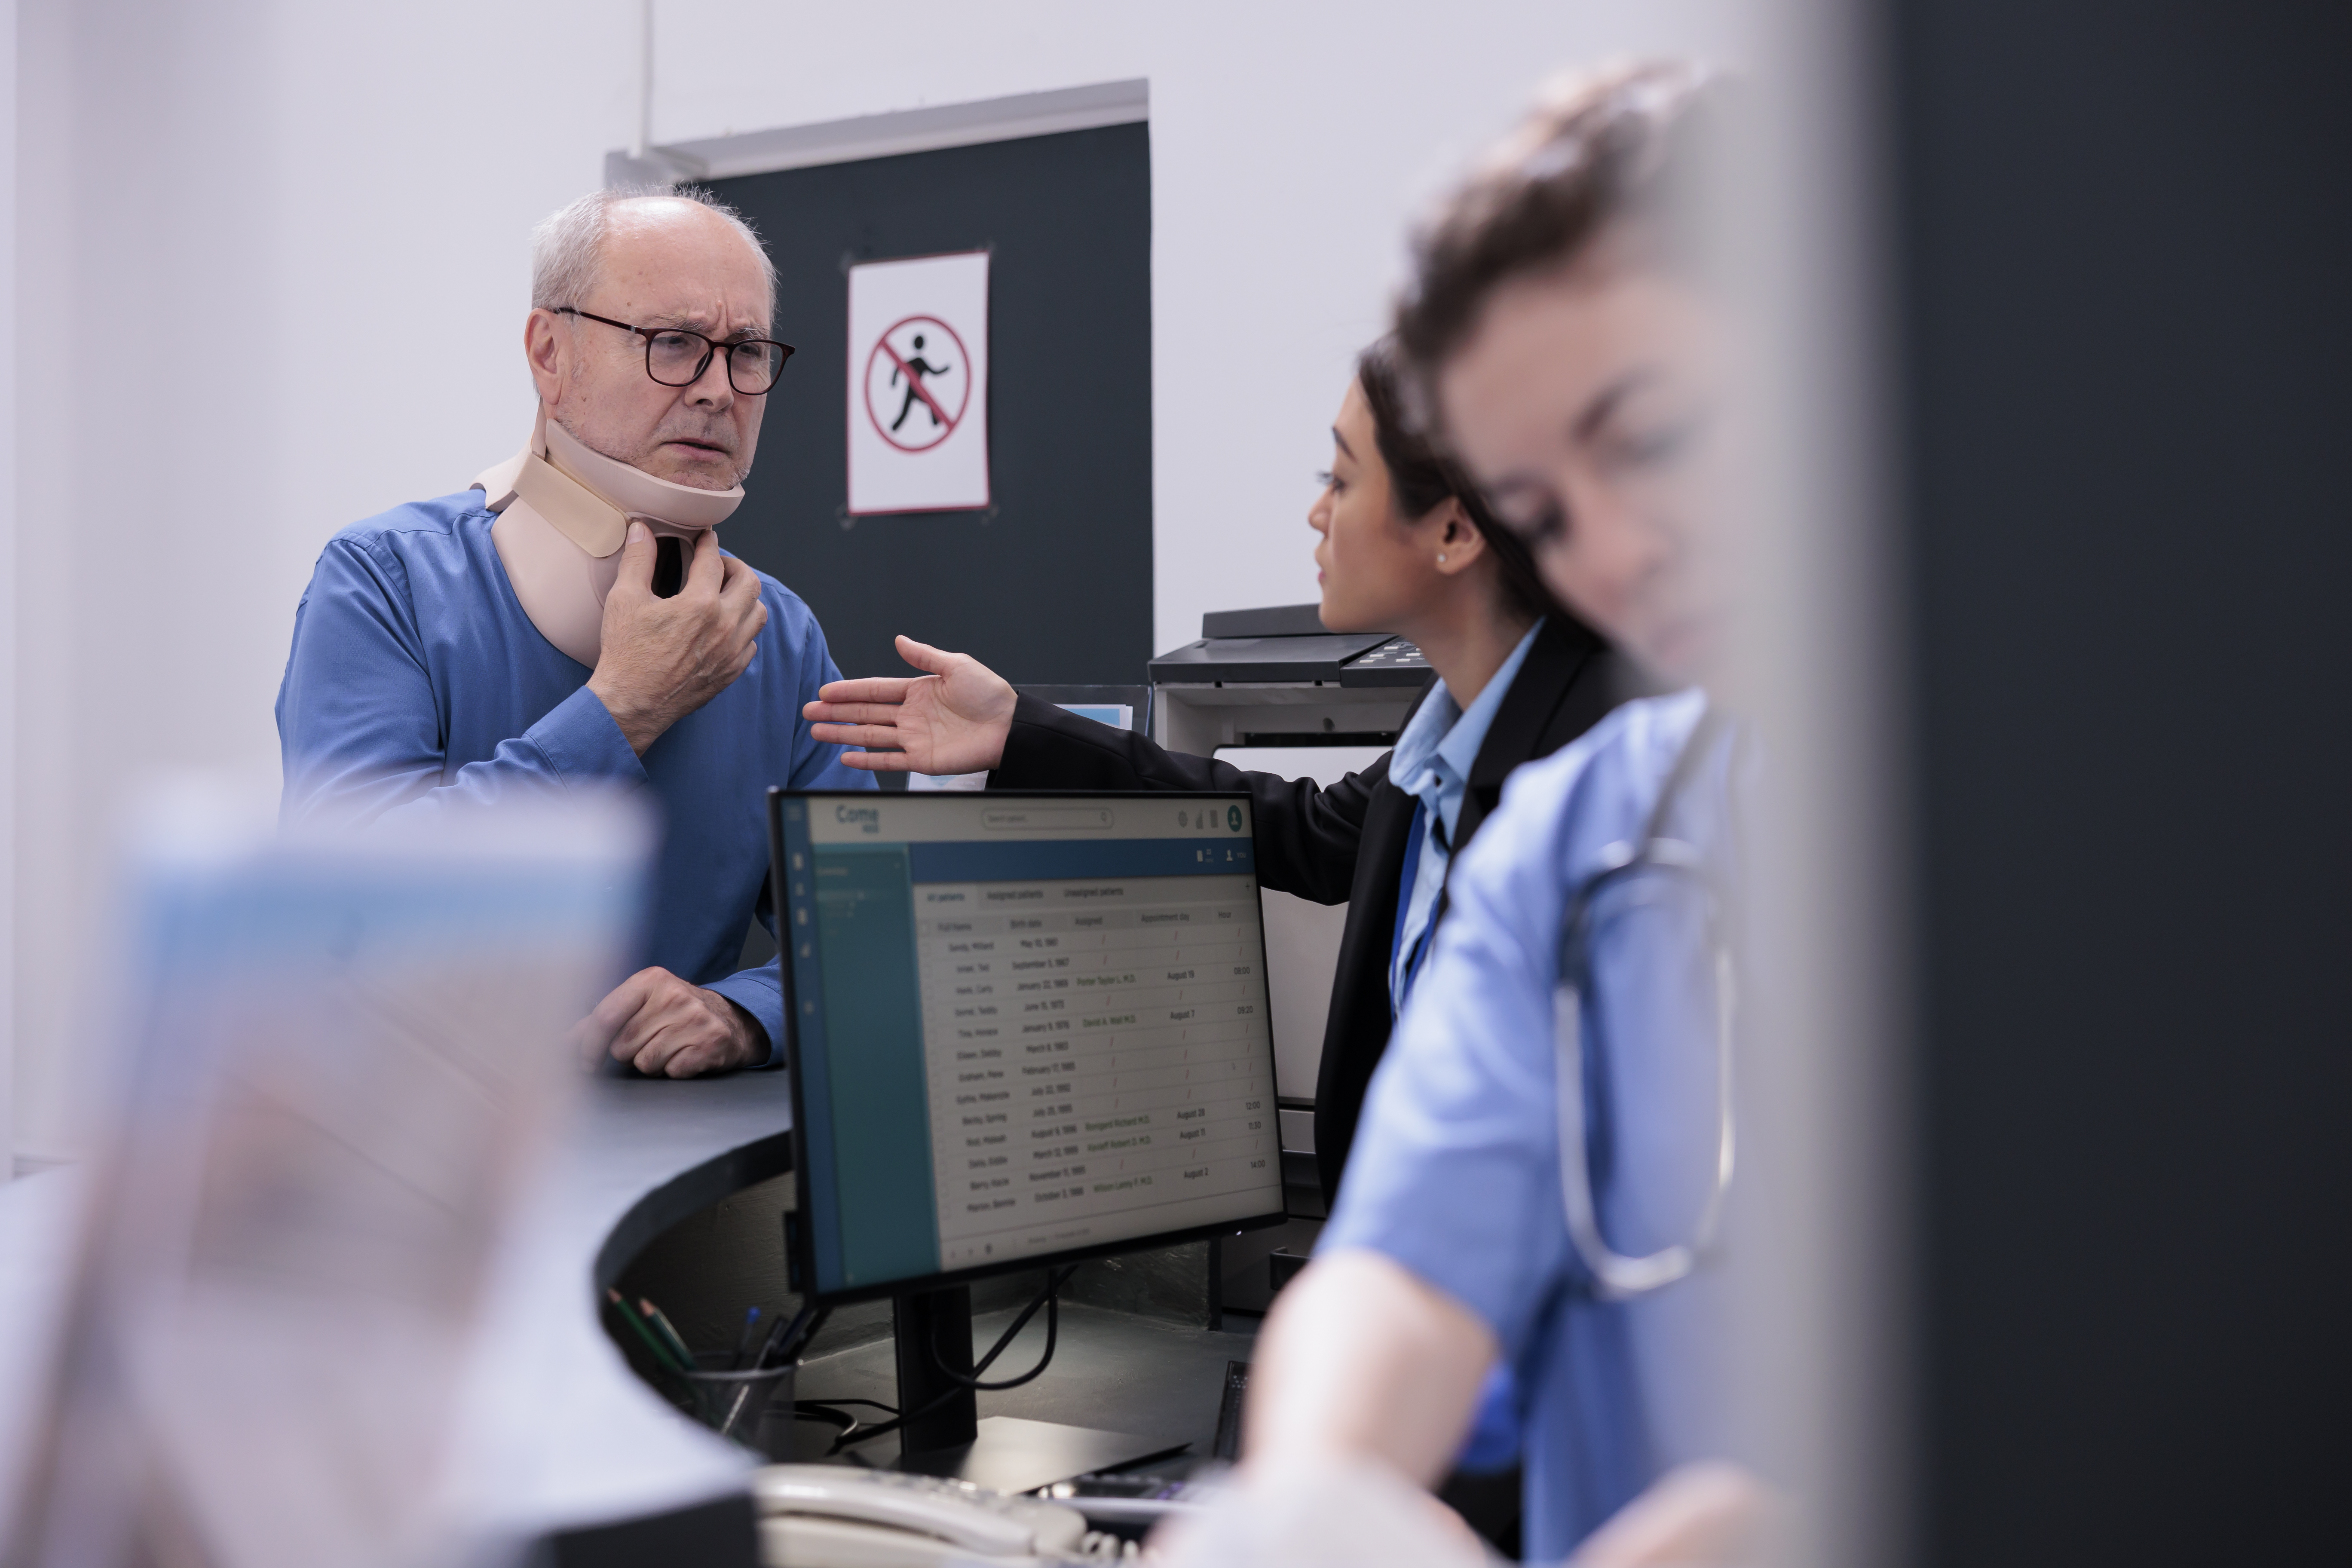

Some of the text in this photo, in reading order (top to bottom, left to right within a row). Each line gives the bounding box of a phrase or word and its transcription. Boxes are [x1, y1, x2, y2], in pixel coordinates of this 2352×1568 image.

[987, 891, 1043, 900] Assigned patients
[1064, 888, 1124, 898] Unassigned patients
[938, 894, 965, 902] patients
[1074, 916, 1103, 927] Assigned
[1140, 913, 1190, 923] Appointment day
[1012, 961, 1046, 970] September
[1234, 966, 1250, 975] 08:00
[1167, 971, 1187, 981] August
[1237, 1005, 1254, 1014] 09:20
[1170, 1011, 1190, 1020] August
[1026, 1045, 1044, 1053] March
[1022, 1066, 1051, 1075] February
[1032, 1087, 1044, 1096] July
[1246, 1101, 1261, 1110] 12:00
[1033, 1109, 1045, 1117] July
[1177, 1110, 1197, 1120] August
[1248, 1121, 1261, 1130] 11:30
[1031, 1129, 1054, 1139] August
[1179, 1130, 1200, 1140] August
[1033, 1150, 1053, 1159] March
[1250, 1159, 1266, 1168] 14:00
[1029, 1171, 1062, 1181] November
[1183, 1167, 1209, 1179] August 2
[1035, 1192, 1061, 1202] October
